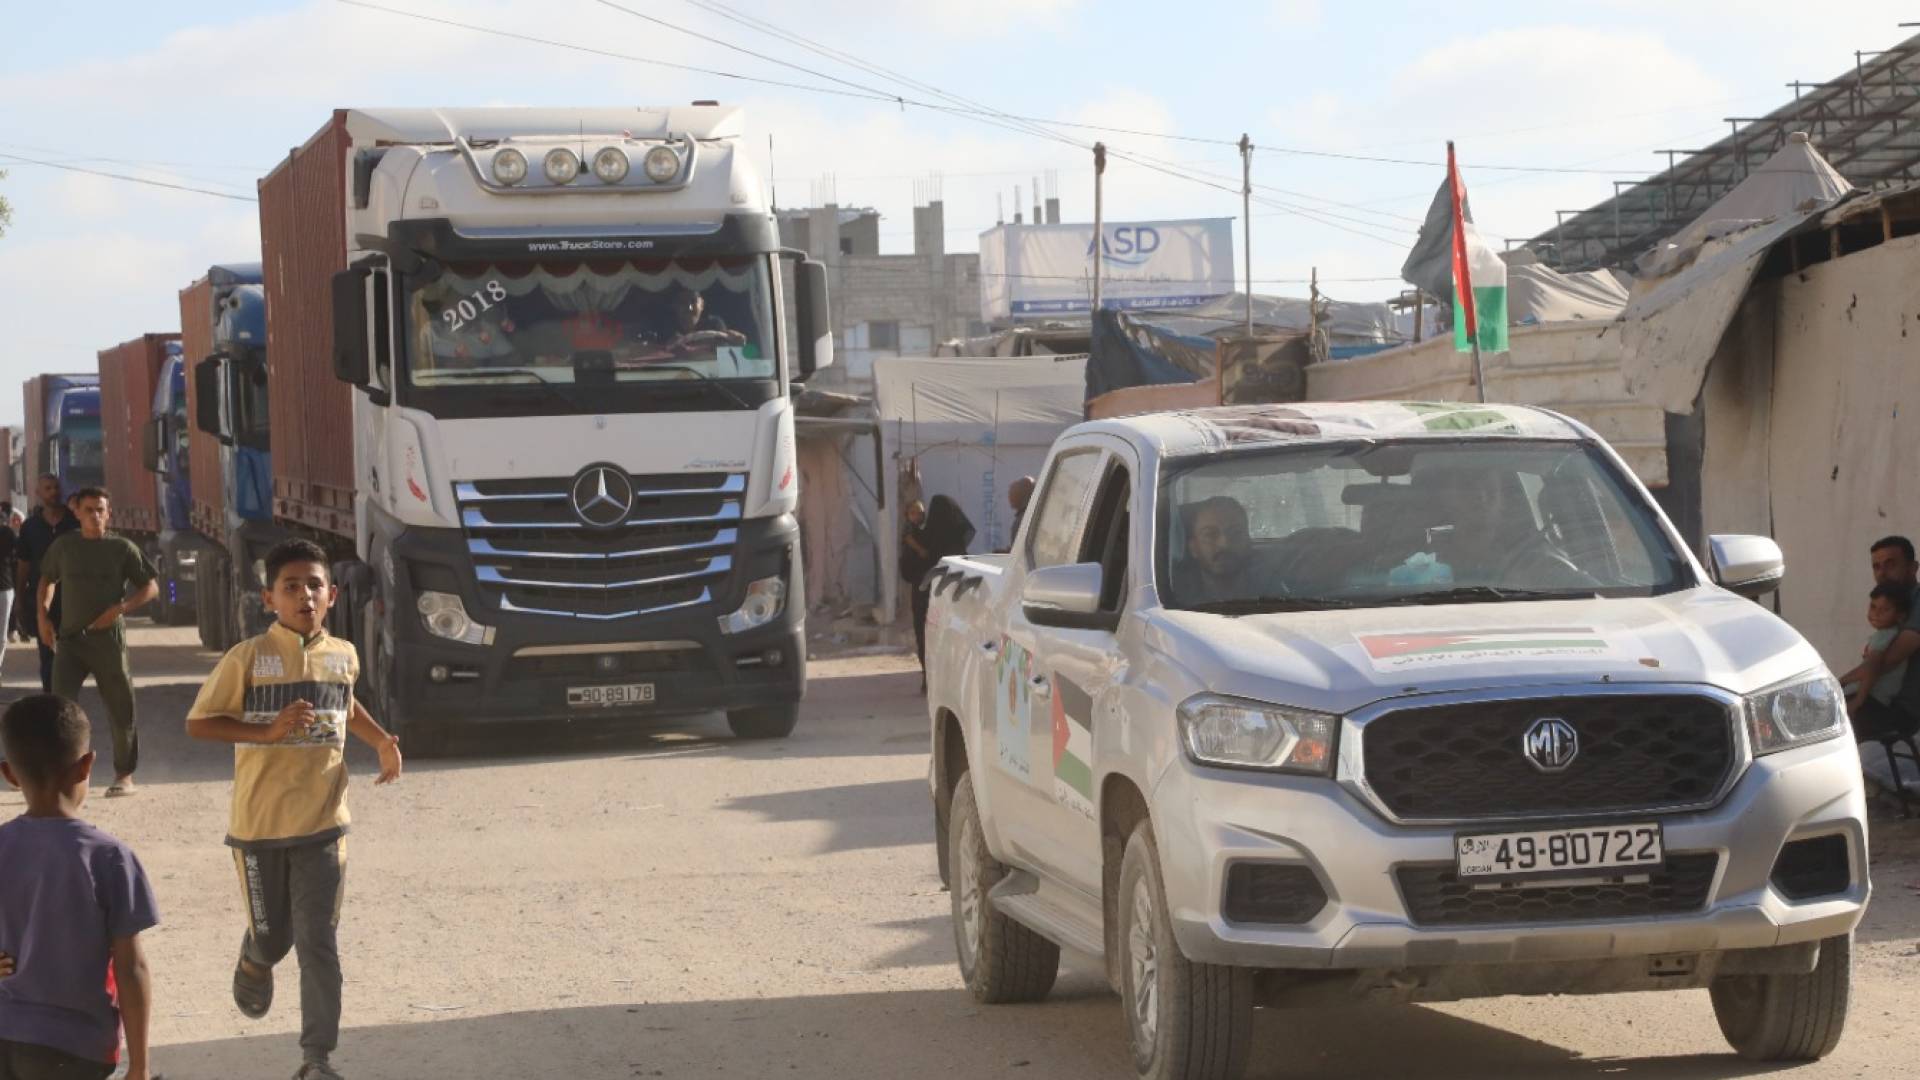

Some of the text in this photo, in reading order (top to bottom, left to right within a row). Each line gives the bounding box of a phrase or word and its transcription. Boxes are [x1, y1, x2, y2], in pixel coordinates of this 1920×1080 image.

[1087, 226, 1160, 255] ASD
[442, 279, 507, 332] 2018
[582, 686, 653, 701] 90-89178
[1531, 721, 1574, 765] MG
[1495, 828, 1657, 870] 49-80722
